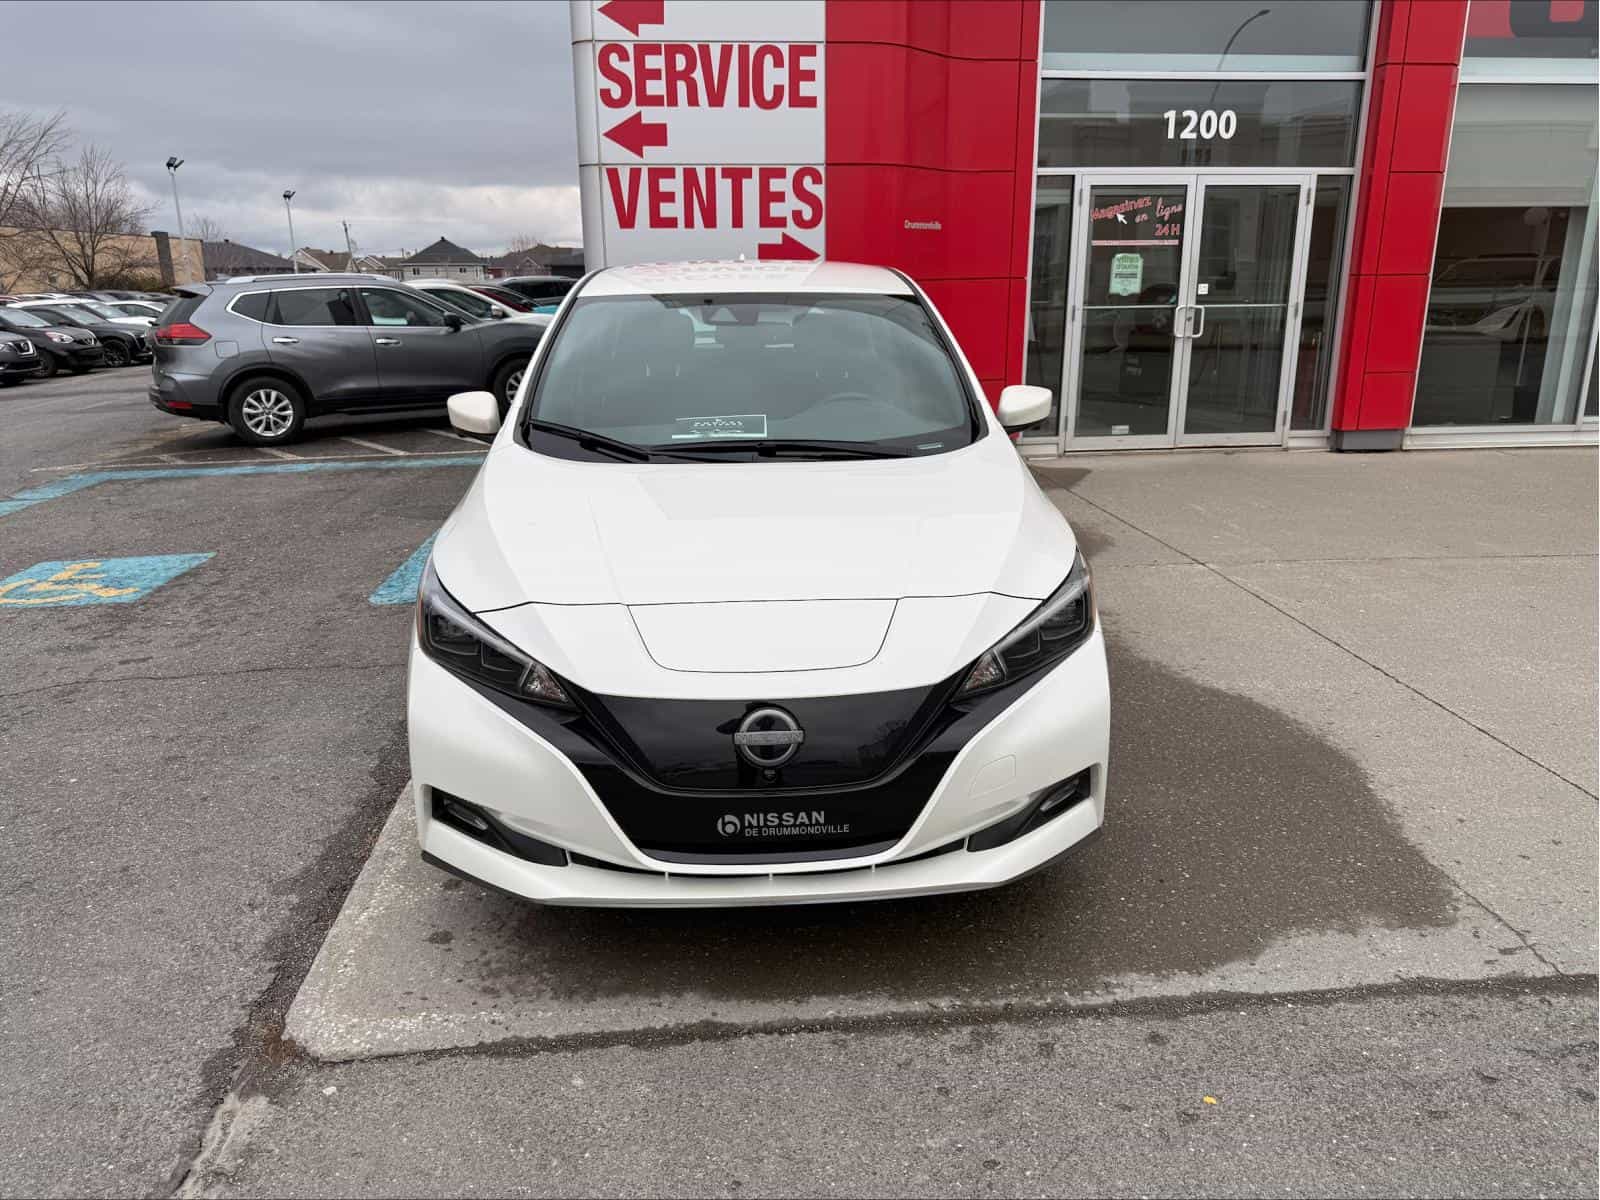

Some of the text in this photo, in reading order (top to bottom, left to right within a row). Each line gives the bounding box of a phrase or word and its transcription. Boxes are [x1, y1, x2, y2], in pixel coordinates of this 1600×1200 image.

[598, 43, 818, 110] SERVICE
[1163, 109, 1237, 140] 1200
[606, 166, 824, 230] VENTES
[1156, 197, 1183, 221] ligne
[1154, 224, 1180, 236] 24 H
[744, 811, 825, 827] NISSAN
[745, 823, 850, 837] DE DRUMMONDVILLE
